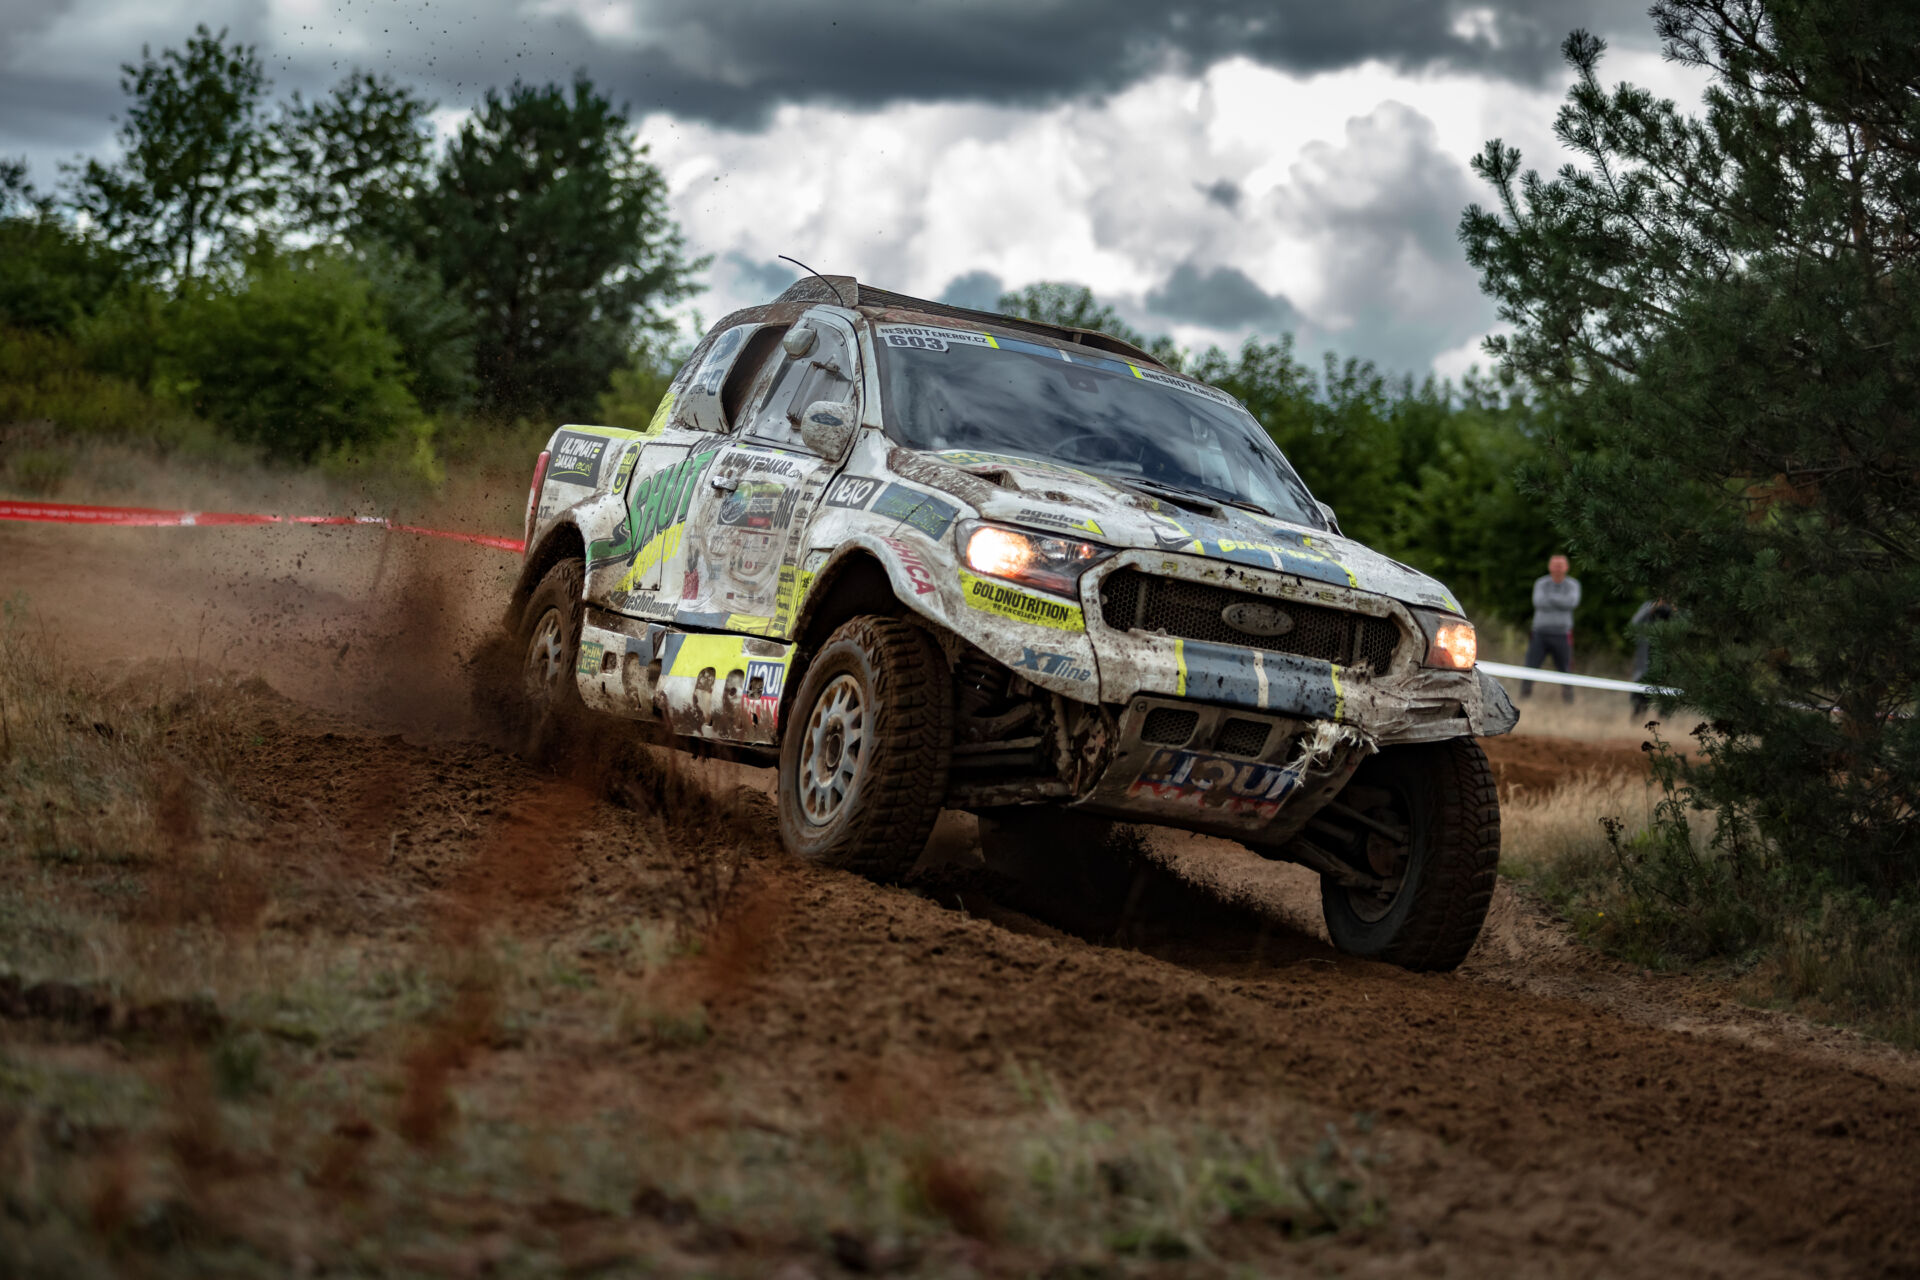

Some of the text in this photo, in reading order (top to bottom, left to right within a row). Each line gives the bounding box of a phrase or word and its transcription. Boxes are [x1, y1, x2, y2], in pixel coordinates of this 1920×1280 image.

[888, 334, 944, 351] 603
[560, 437, 604, 459] ULTIMATE
[554, 453, 578, 470] DAKAR
[773, 487, 801, 530] 603
[1019, 507, 1086, 526] agados
[972, 581, 1070, 622] GOLDNUTRITION
[1013, 647, 1092, 682] XTline
[745, 664, 783, 695] LIQUI
